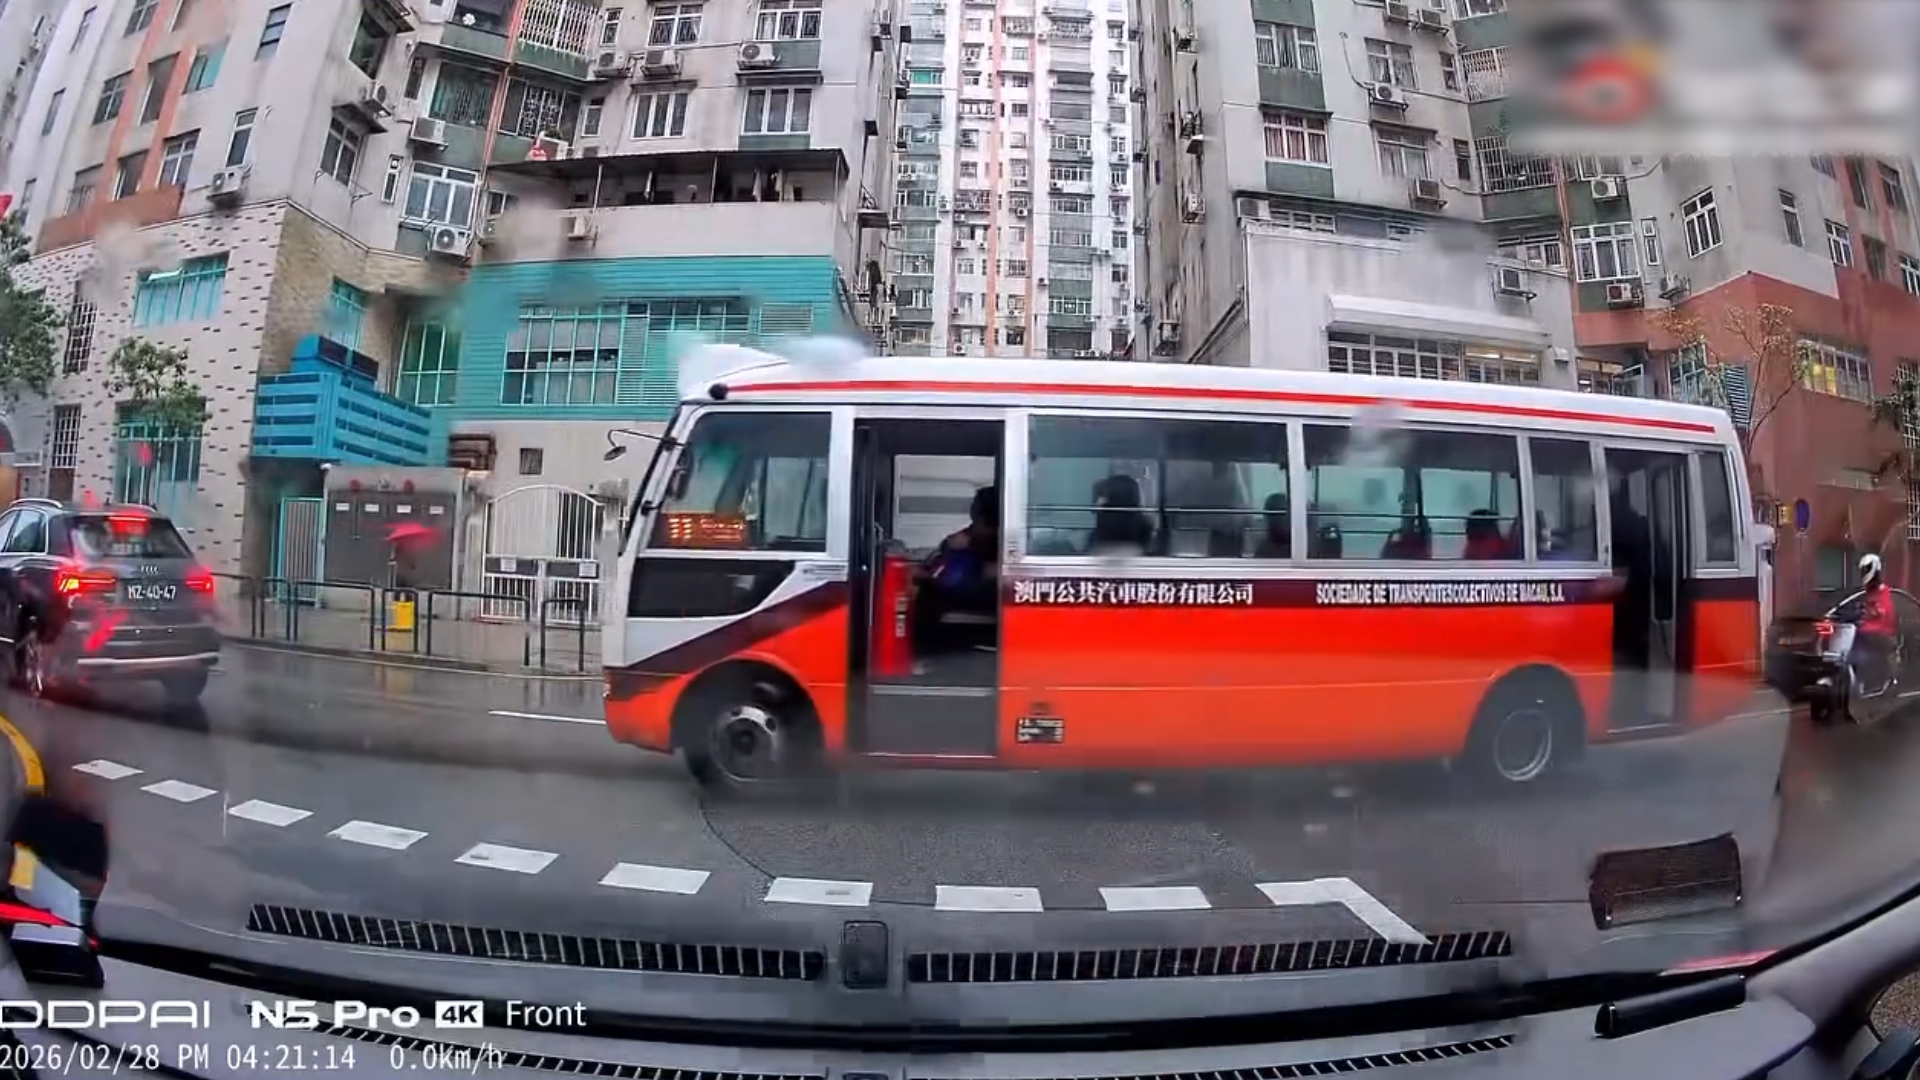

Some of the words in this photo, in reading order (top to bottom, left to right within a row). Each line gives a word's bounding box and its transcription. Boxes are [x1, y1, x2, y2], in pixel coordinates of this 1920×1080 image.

[1014, 581, 1253, 605] 澳門公共汽車股份有限公司
[1316, 583, 1371, 605] SOCIEDADE
[1373, 583, 1387, 604] DE
[1506, 583, 1518, 603] DE
